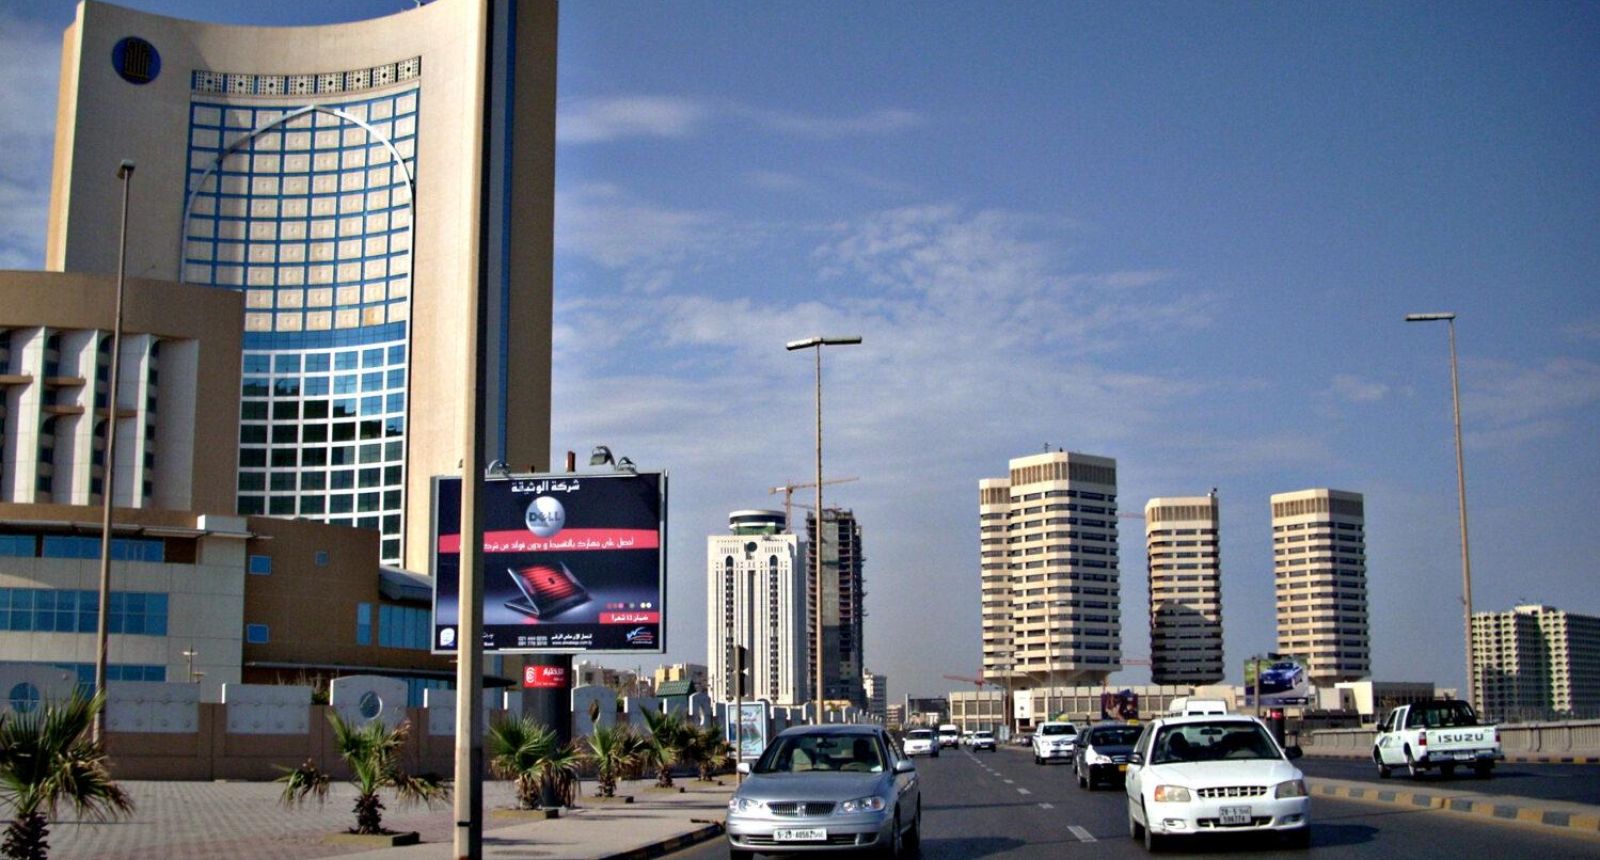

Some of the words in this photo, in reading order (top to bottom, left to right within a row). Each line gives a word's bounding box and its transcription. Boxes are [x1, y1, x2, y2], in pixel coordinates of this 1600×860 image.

[551, 479, 580, 493] شركة
[528, 511, 561, 522] DELL
[1438, 733, 1484, 743] ISUZU
